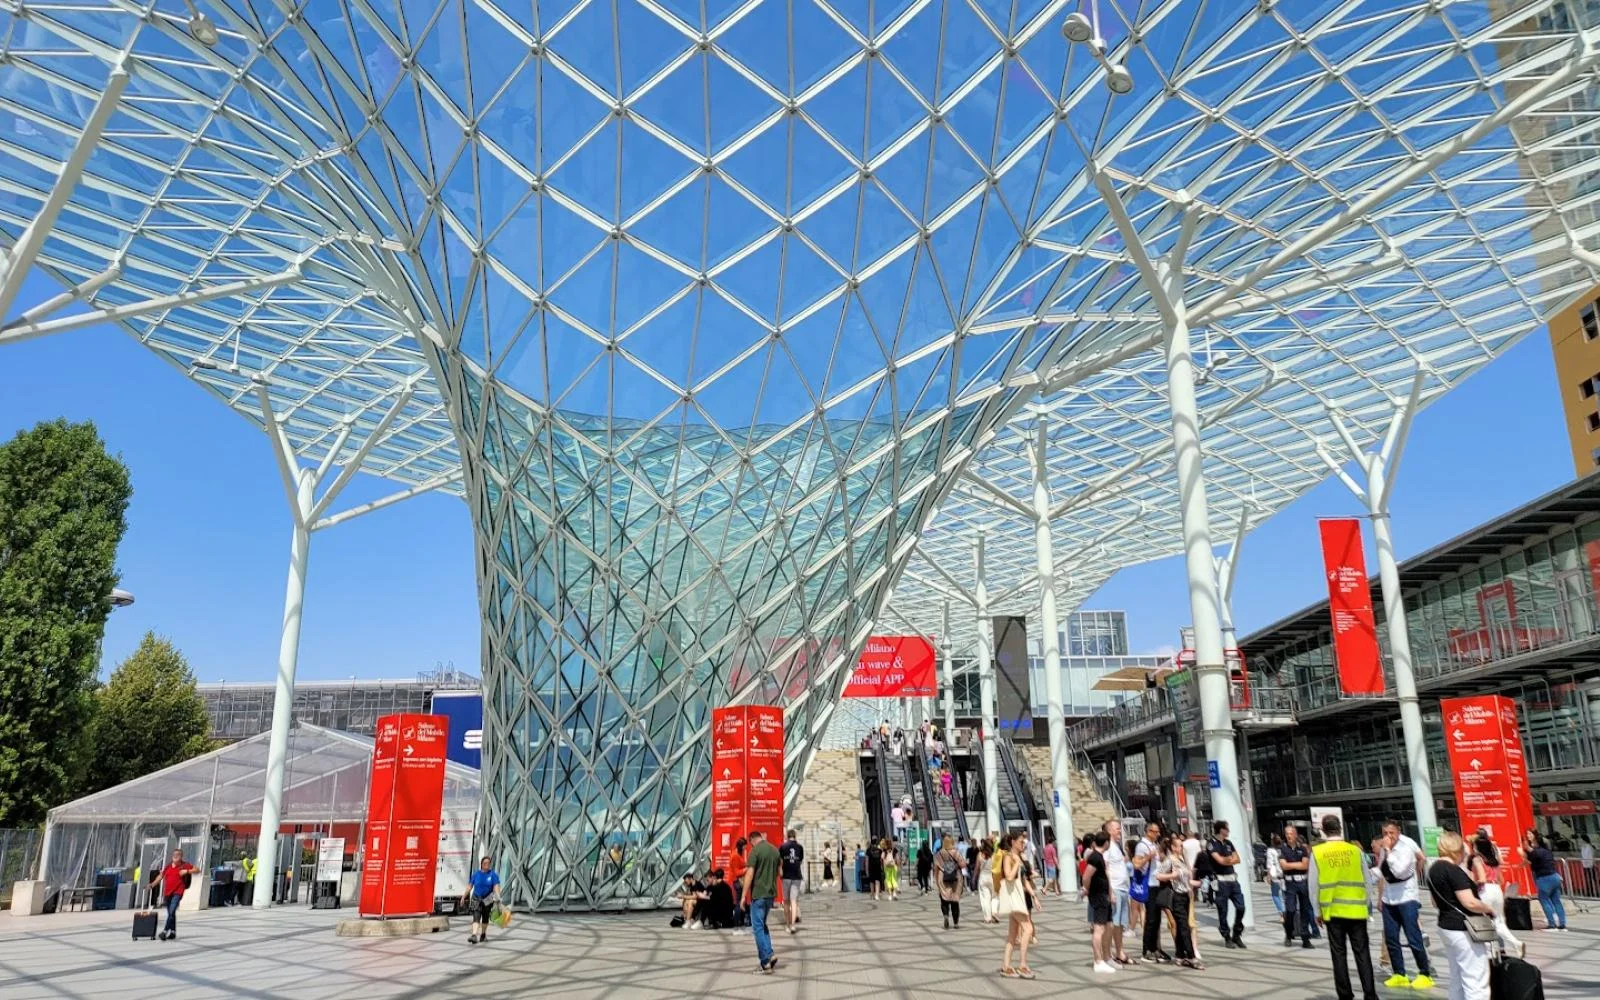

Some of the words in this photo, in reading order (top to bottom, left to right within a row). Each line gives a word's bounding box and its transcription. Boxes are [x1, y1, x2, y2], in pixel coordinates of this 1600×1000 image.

[868, 661, 891, 669] wave
[893, 655, 904, 669] &
[884, 673, 905, 685] APP
